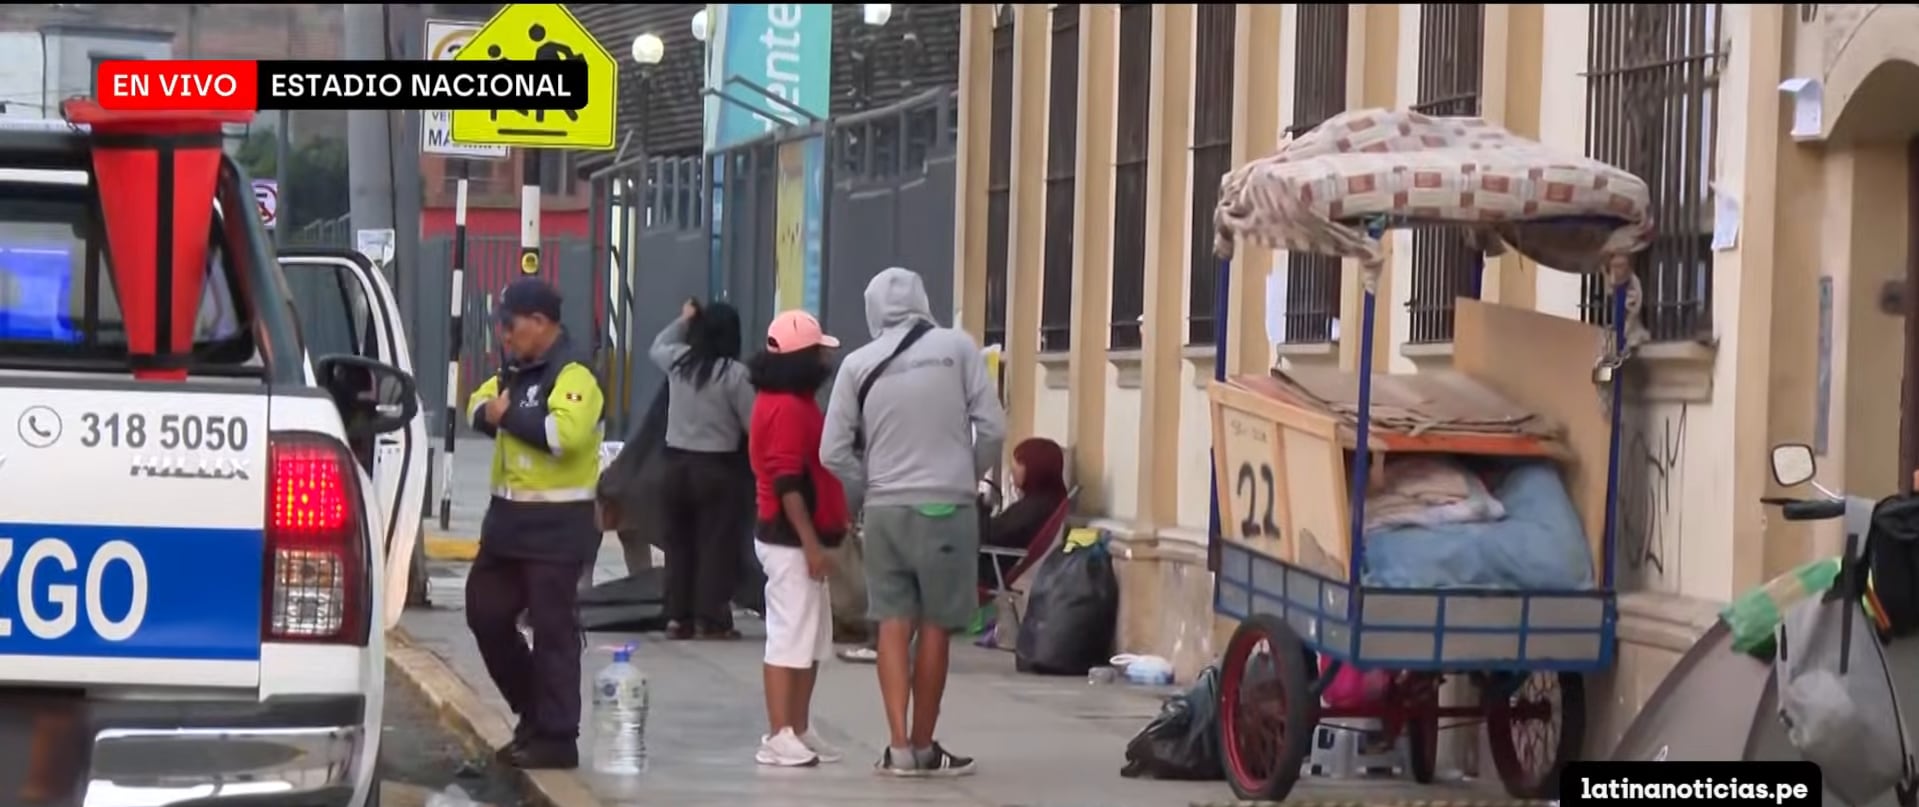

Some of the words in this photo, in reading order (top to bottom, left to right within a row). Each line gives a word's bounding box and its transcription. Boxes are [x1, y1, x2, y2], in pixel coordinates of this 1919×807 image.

[81, 412, 146, 448] 318
[160, 414, 248, 451] 5050
[0, 537, 148, 641] GO
